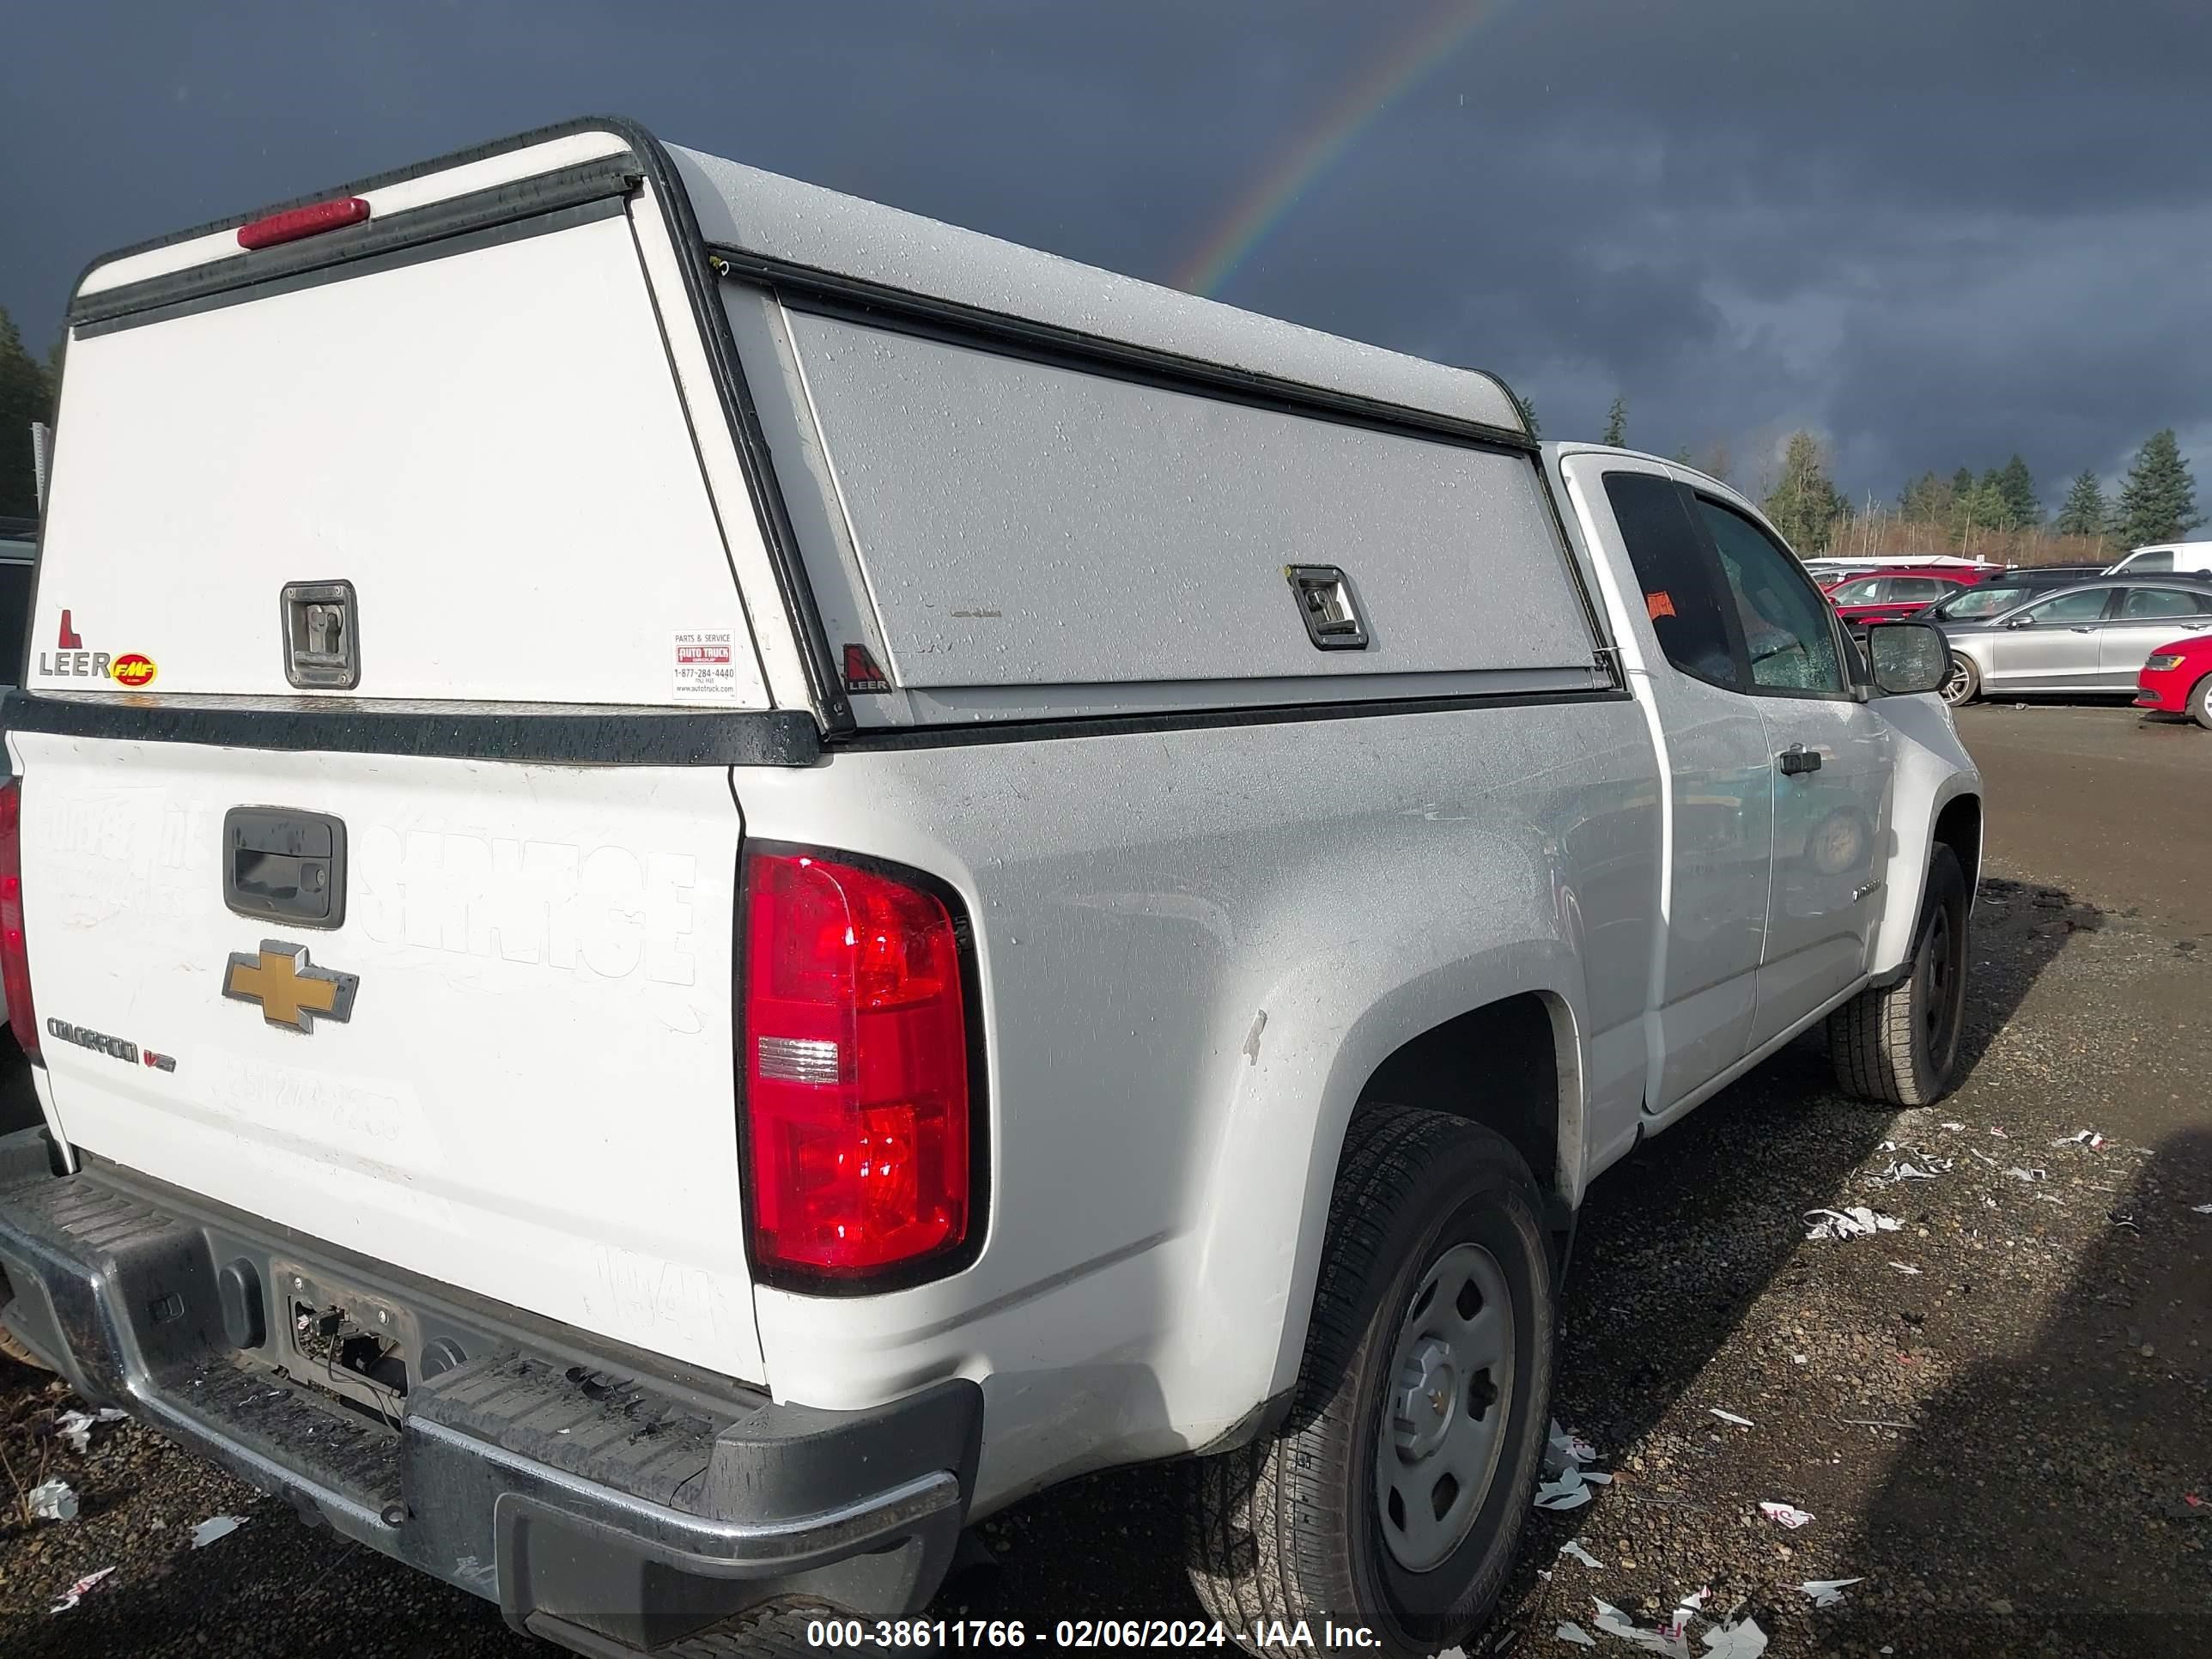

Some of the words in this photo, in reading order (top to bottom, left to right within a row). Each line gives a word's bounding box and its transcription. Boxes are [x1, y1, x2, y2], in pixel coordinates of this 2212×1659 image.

[705, 634, 731, 642] SERVICE
[678, 647, 702, 661] AUTO
[703, 647, 729, 658] TRUCK
[39, 652, 111, 678] LEER
[112, 661, 155, 677] FMF
[675, 669, 734, 678] 1-877-284-4440
[849, 680, 887, 690] LEER
